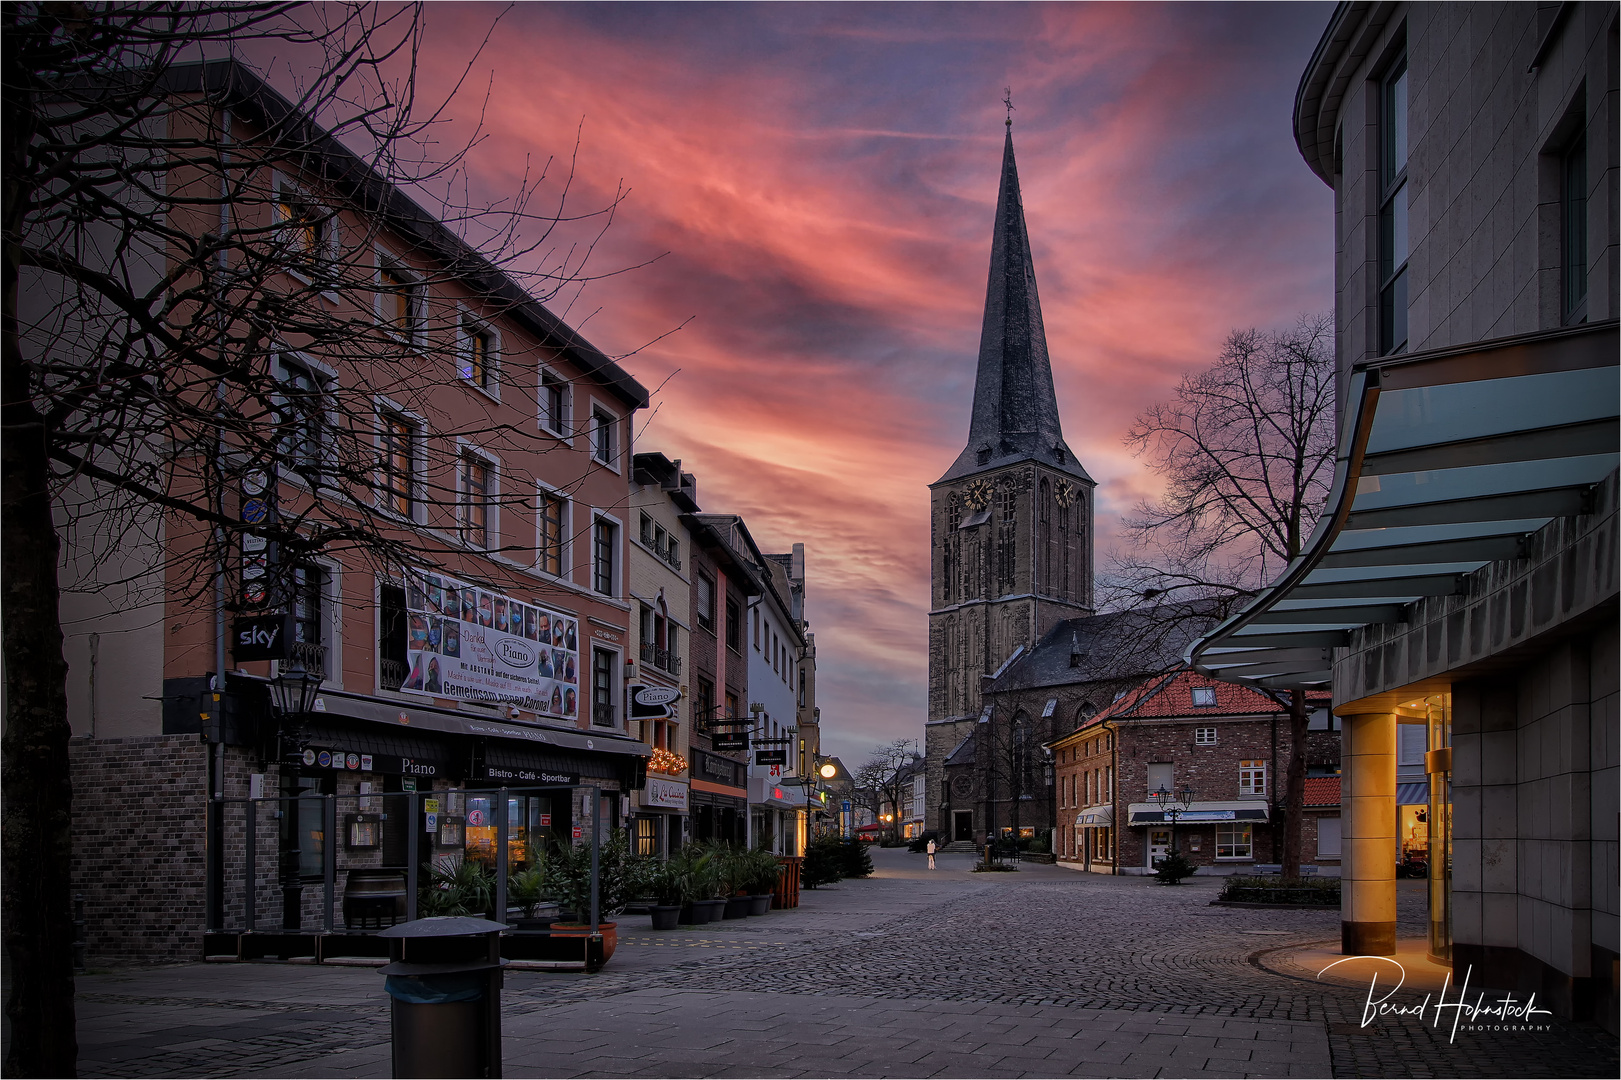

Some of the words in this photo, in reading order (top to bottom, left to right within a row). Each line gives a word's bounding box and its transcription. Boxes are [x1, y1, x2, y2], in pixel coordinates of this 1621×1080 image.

[239, 623, 280, 649] sky
[464, 630, 484, 644] Danke
[502, 643, 528, 661] Piano
[460, 662, 468, 670] Mit
[470, 665, 494, 676] ABSTAND
[510, 673, 527, 683] sicheren
[443, 681, 498, 701] Gemeinsam
[497, 693, 524, 706] gegen
[524, 695, 550, 712] Corona!
[643, 693, 669, 701] Piano
[401, 757, 436, 775] Piano
[488, 768, 513, 779] Bistro
[518, 771, 536, 780] Café
[541, 772, 571, 783] Sportbar
